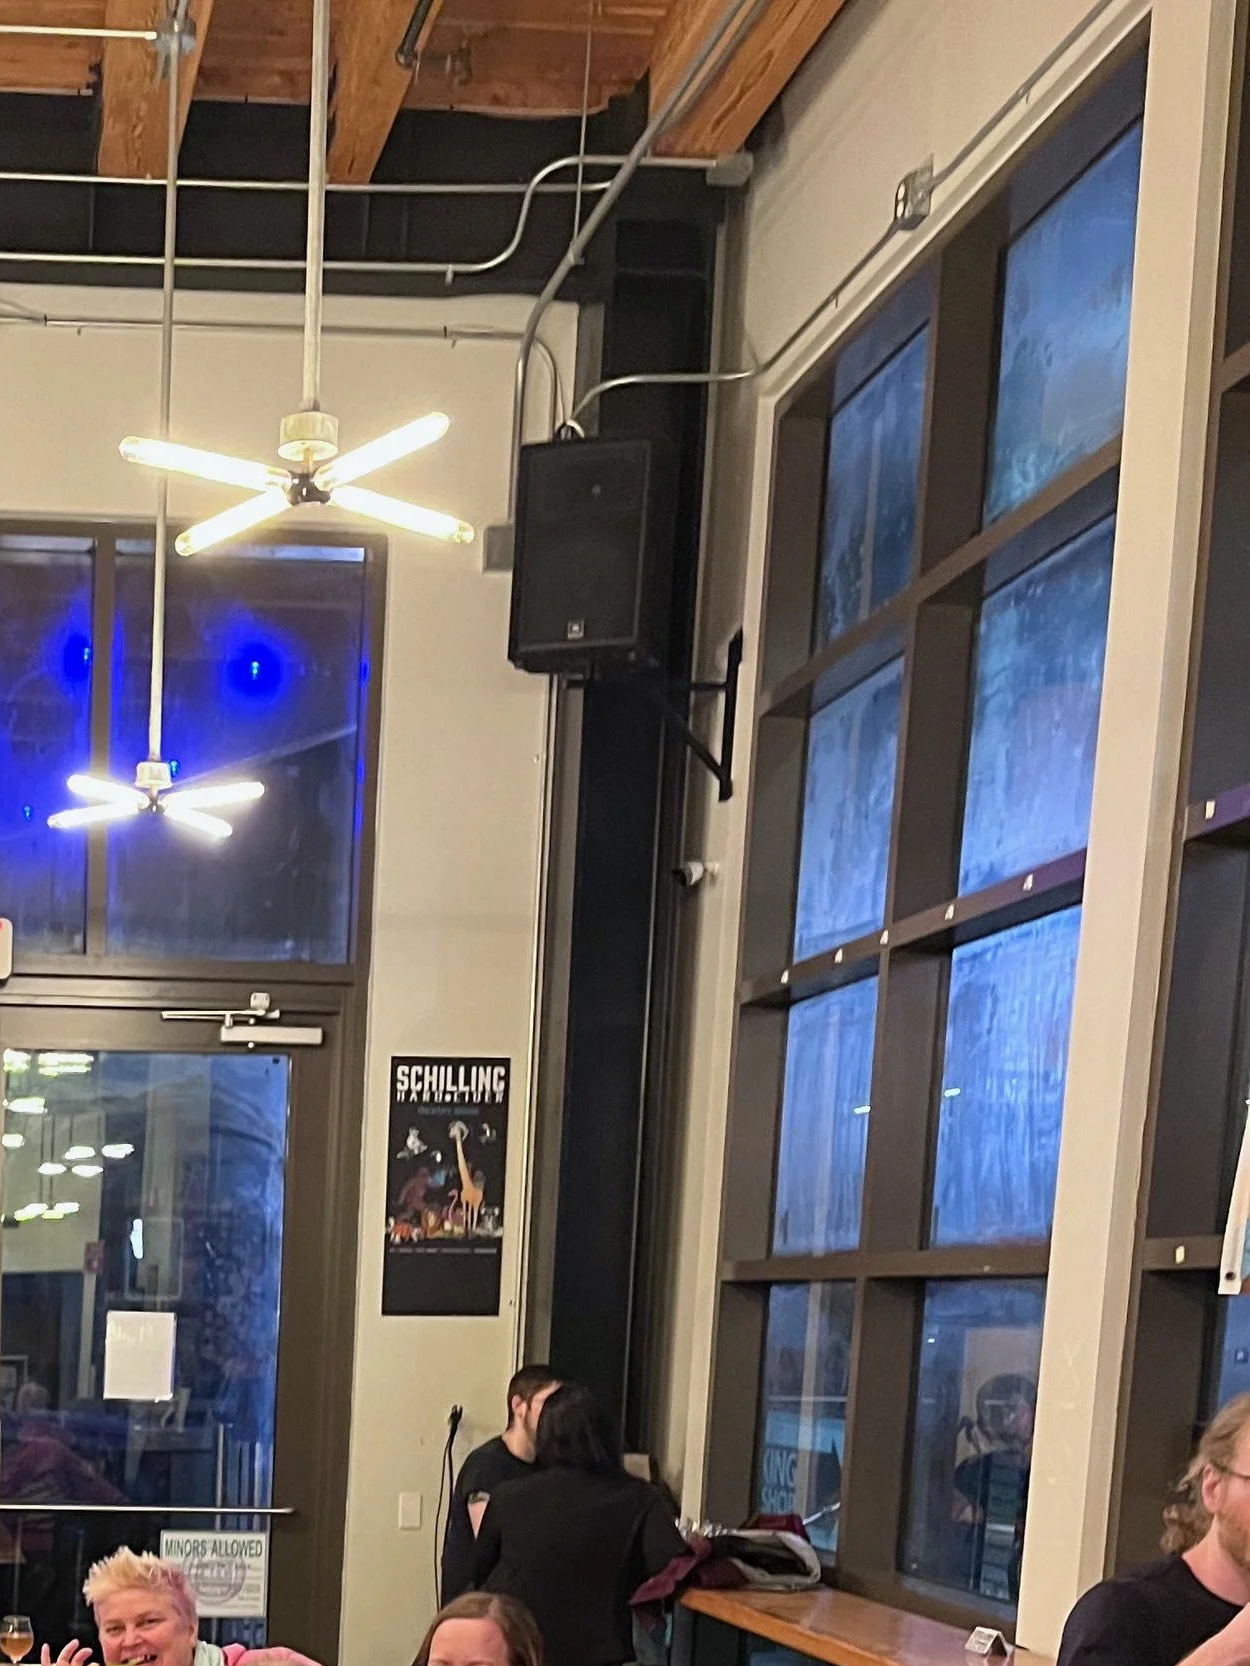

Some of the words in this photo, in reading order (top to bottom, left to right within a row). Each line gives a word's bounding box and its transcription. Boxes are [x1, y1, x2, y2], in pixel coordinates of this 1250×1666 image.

[397, 1065, 505, 1092] SCHILLING
[165, 1538, 207, 1557] MINORS
[211, 1540, 263, 1557] ALLOWED
